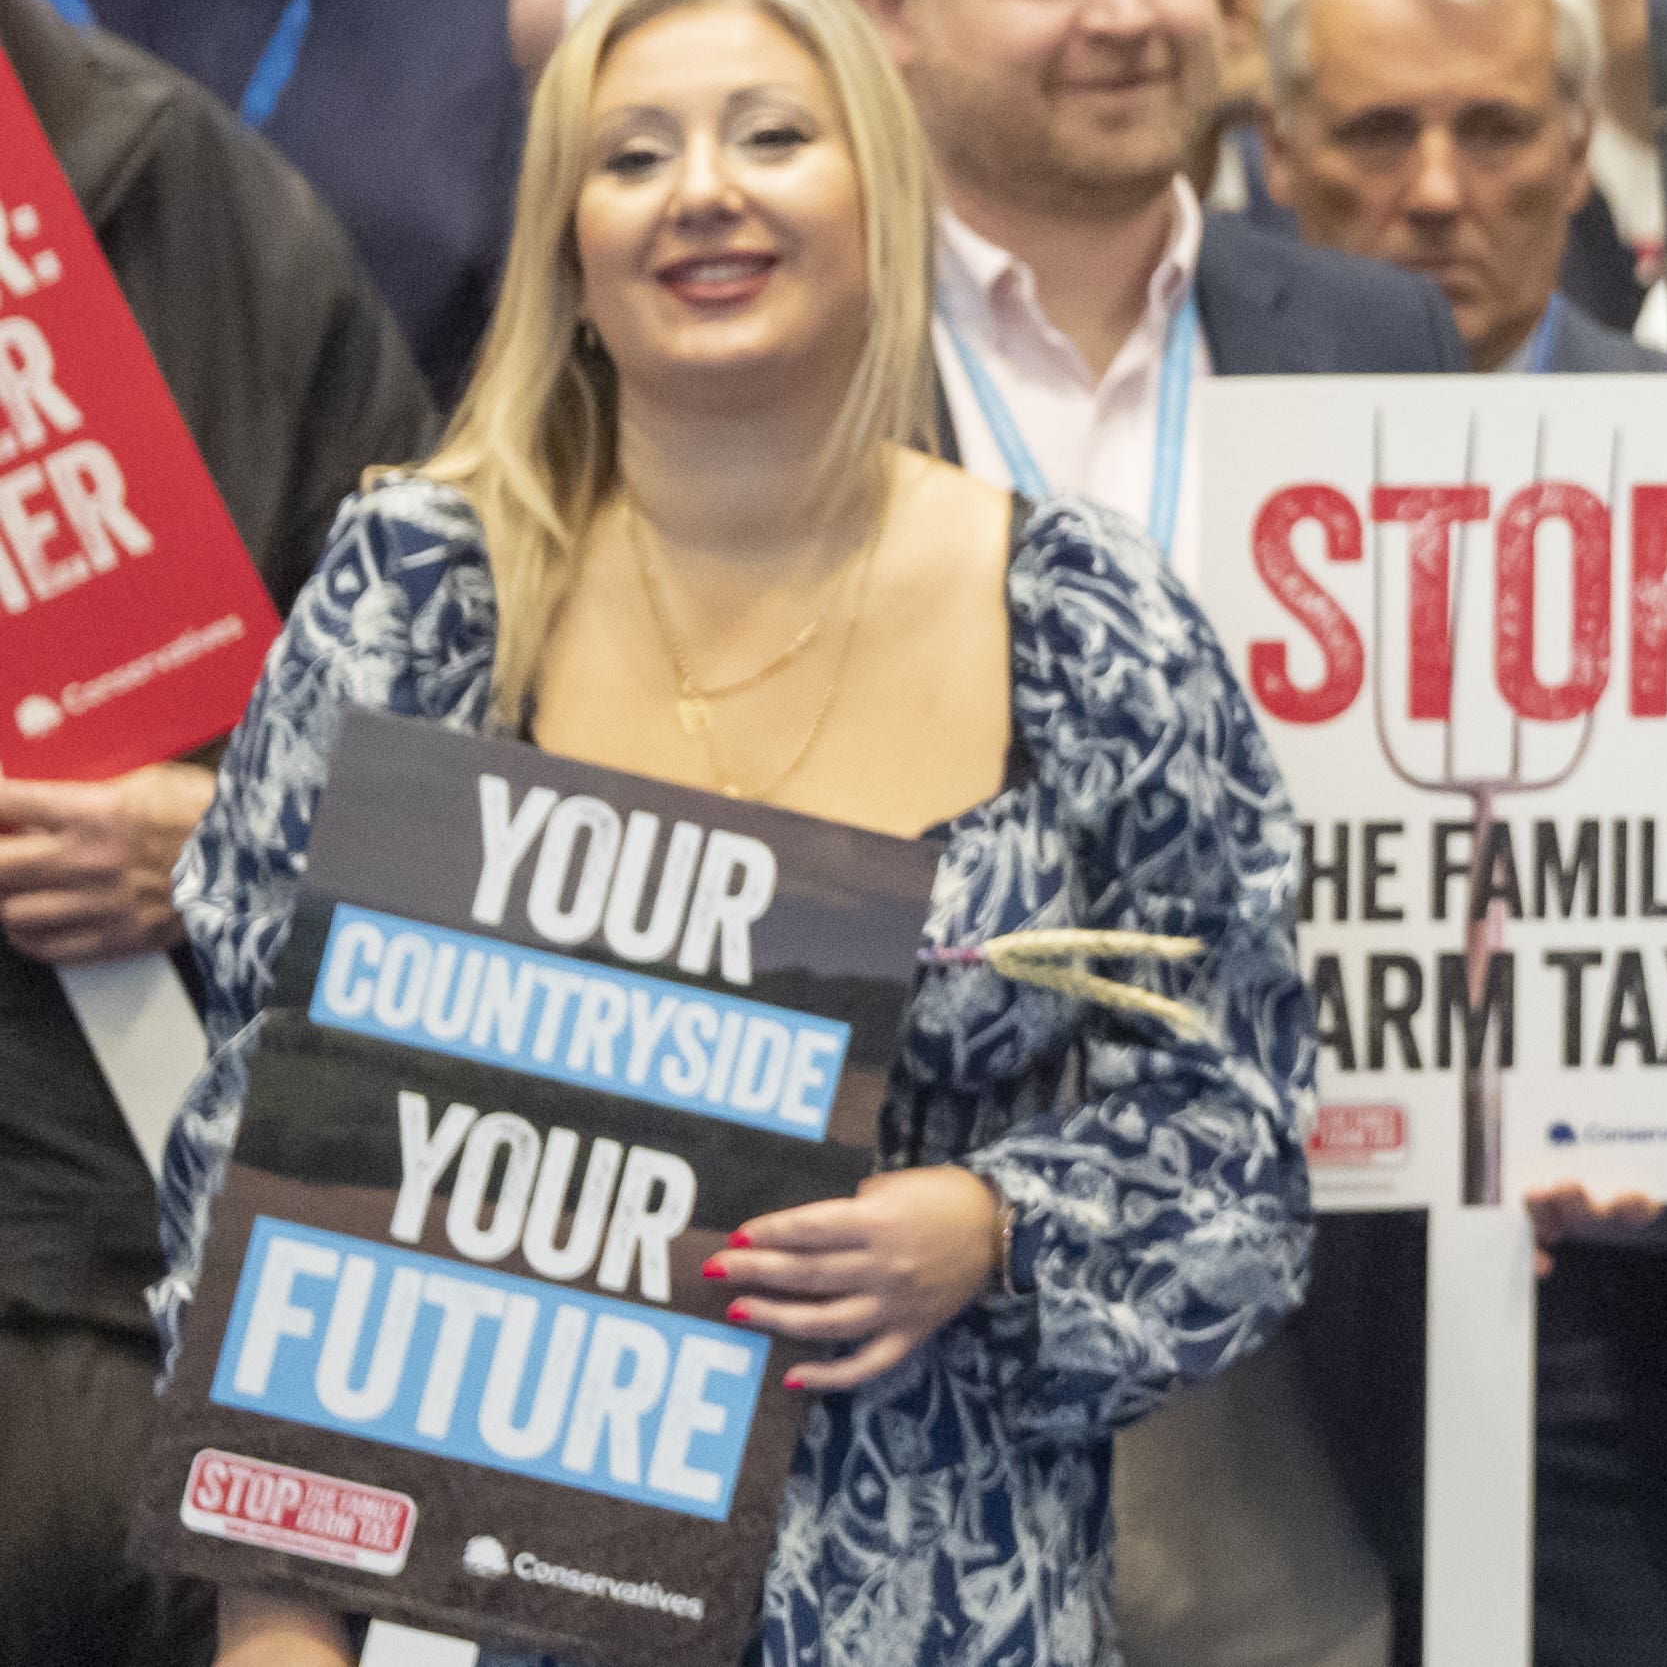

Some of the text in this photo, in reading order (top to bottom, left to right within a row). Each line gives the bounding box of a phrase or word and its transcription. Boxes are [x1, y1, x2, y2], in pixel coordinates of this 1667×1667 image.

[469, 774, 777, 986] YOUR
[1296, 819, 1404, 922] HE
[322, 920, 843, 1127] COUNTRYSIDE
[1313, 951, 1516, 1072] ARM
[388, 1089, 698, 1302] YOUR
[232, 1235, 753, 1505] FUTURE
[194, 1458, 302, 1524] STOP
[513, 1551, 705, 1621] Conservatives
